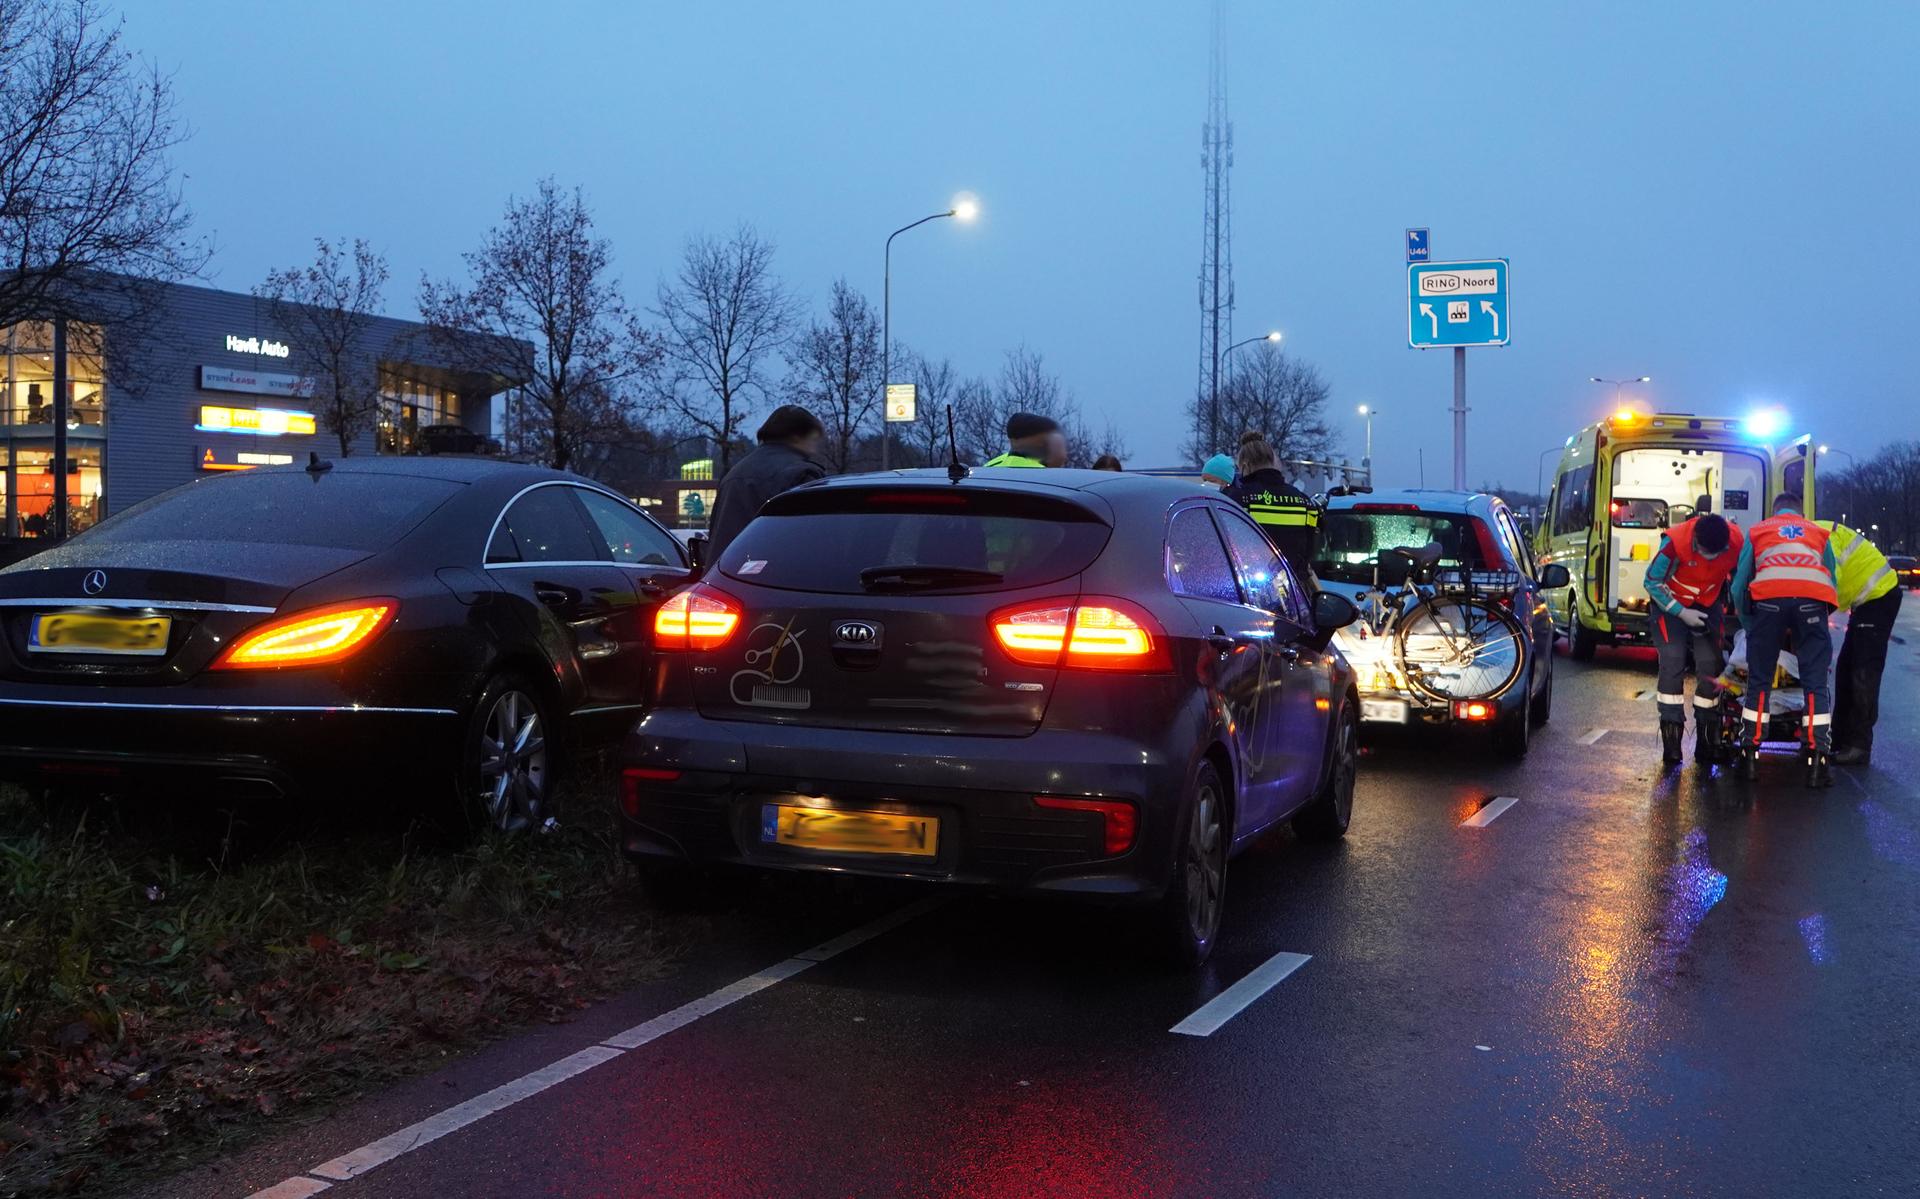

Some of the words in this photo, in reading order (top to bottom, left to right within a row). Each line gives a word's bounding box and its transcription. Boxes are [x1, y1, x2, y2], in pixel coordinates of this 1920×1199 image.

[1427, 279, 1456, 288] RING
[1463, 278, 1495, 287] Noord
[226, 335, 260, 354] Havik
[260, 340, 289, 358] Auto
[1257, 494, 1301, 505] POLITIE
[842, 627, 868, 640] KIA
[694, 666, 717, 676] RIO
[763, 827, 776, 837] NL
